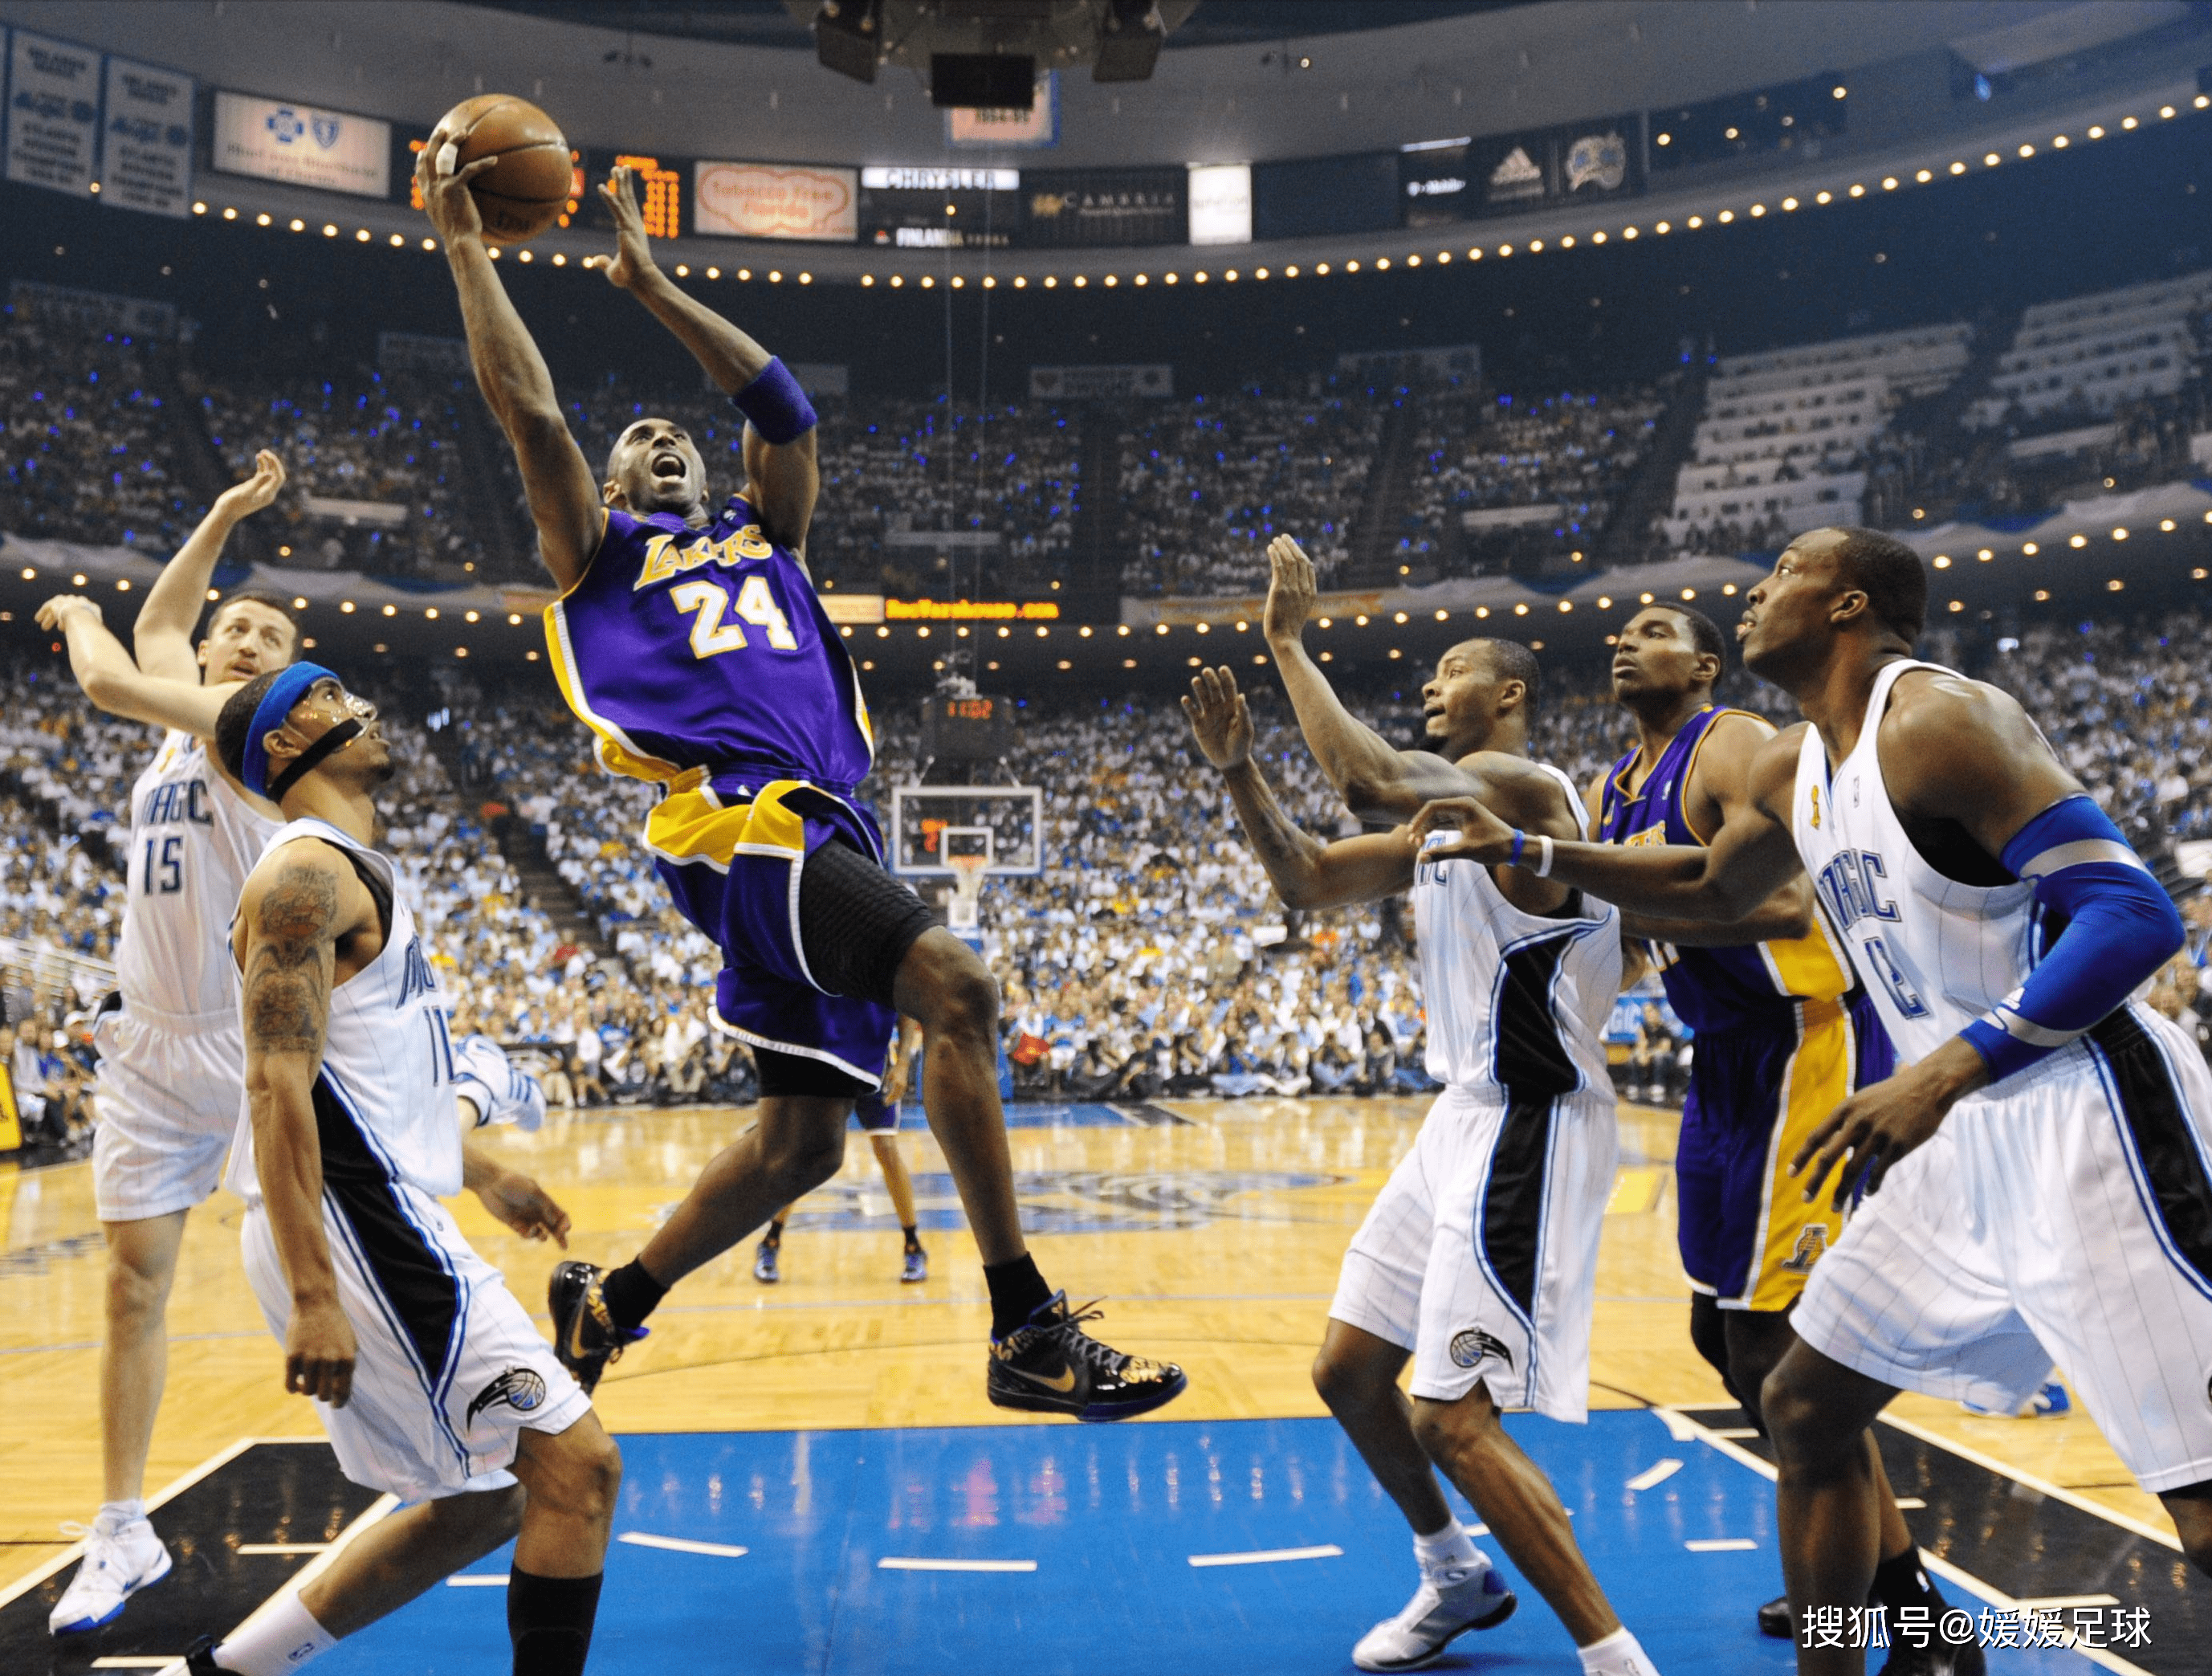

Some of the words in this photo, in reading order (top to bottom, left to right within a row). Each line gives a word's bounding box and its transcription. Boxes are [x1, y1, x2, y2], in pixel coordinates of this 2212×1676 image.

[669, 576, 798, 660] 24
[144, 836, 182, 896] 15
[423, 1005, 454, 1087] 11
